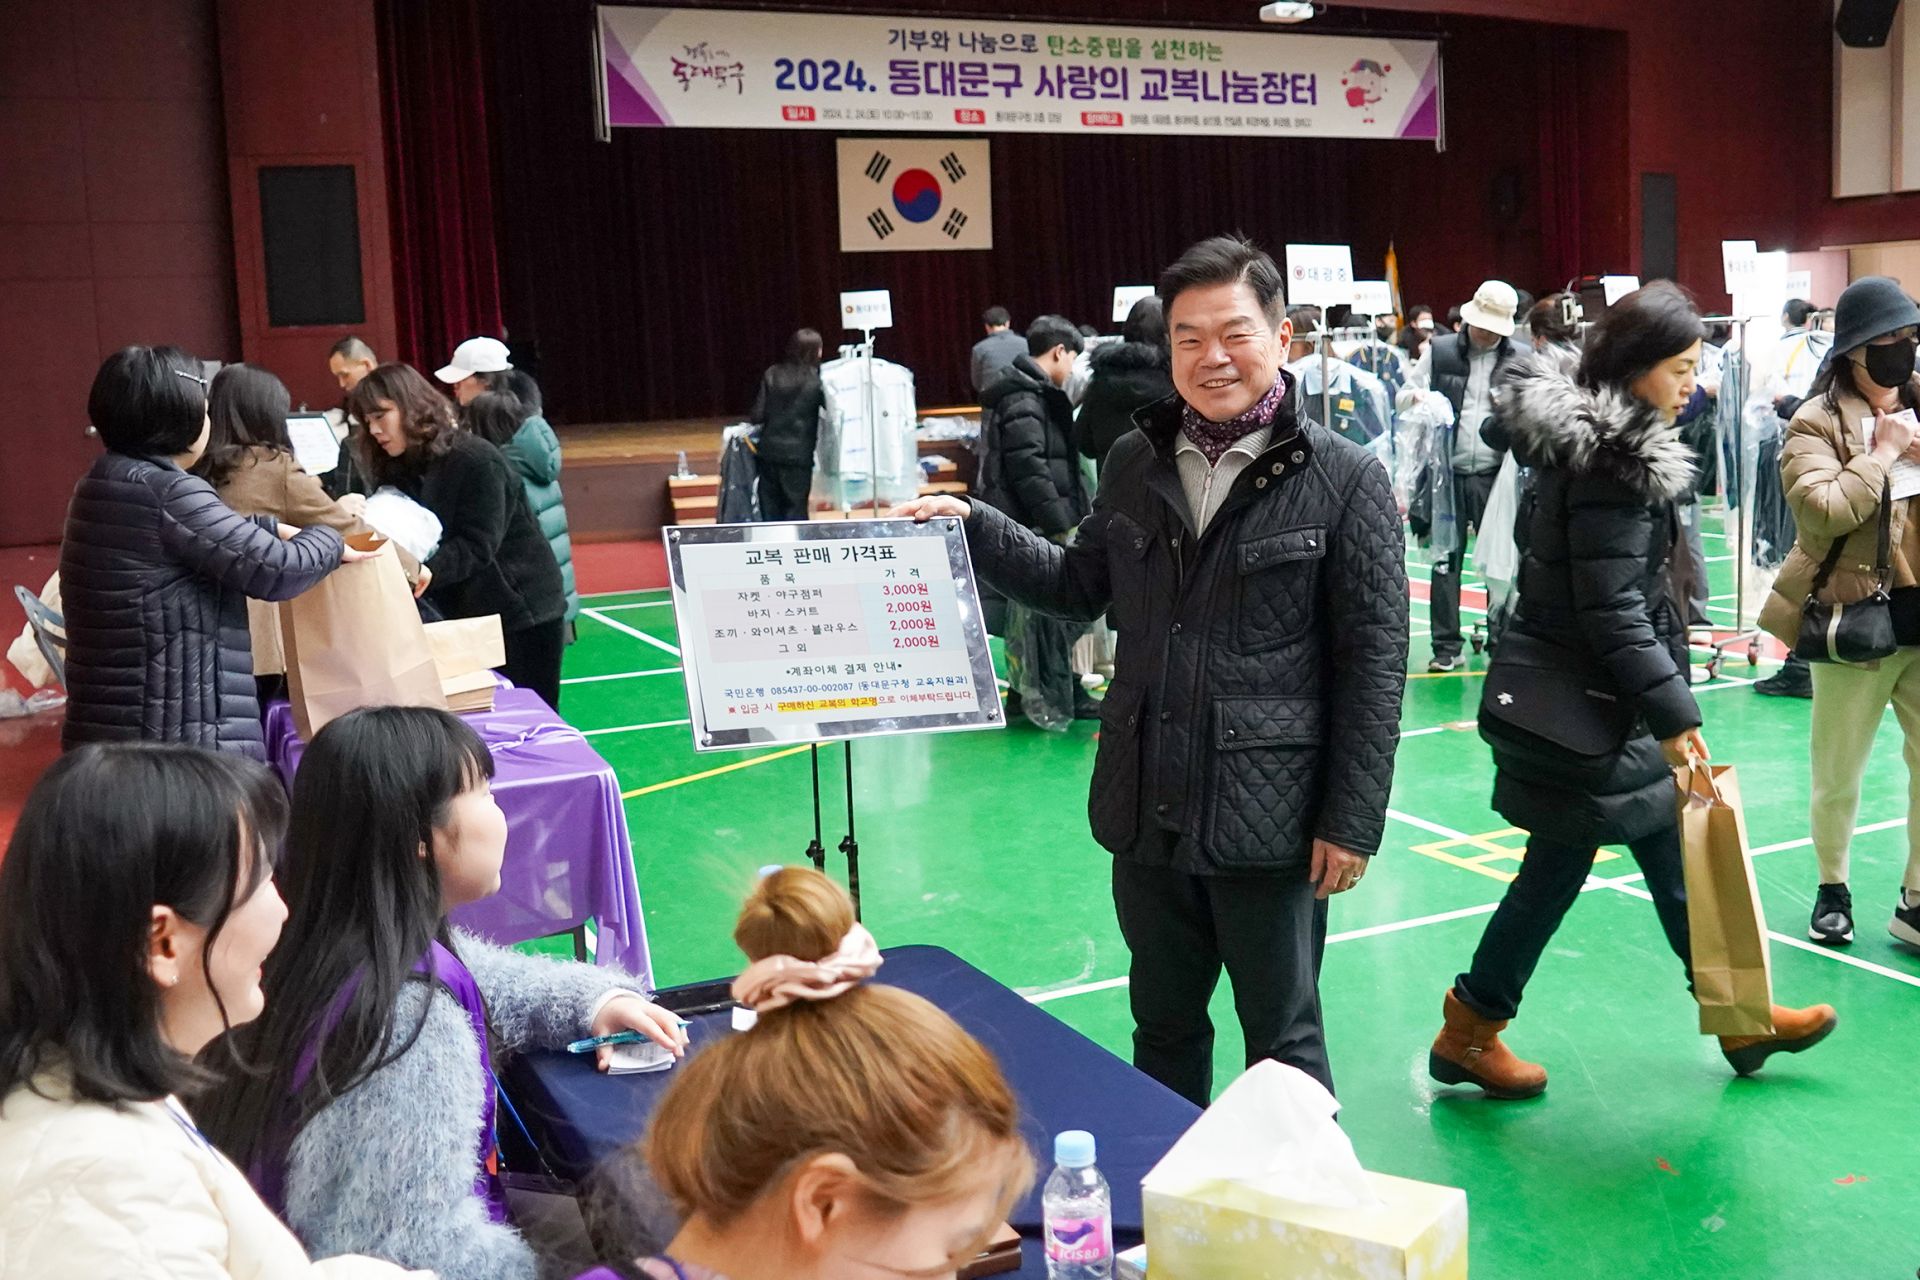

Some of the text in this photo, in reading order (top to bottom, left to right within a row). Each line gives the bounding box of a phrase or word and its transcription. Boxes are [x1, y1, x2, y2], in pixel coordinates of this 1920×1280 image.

[889, 29, 1223, 62] 기부와 나눔으로 탄소중립을 실천하는
[775, 58, 1318, 106] 2024. 동대문구 사랑의 교복나눔장터
[745, 545, 897, 566] 교복 판매 가격표
[737, 588, 823, 602] 자켓 야구점퍼
[883, 583, 929, 596] 3,000원
[747, 606, 819, 619] 바지 스커트
[886, 600, 933, 613] 2,000원
[715, 622, 858, 638] 조끼 와이셔츠 블라우스
[889, 618, 936, 631] 2,000원
[779, 642, 807, 653] 그 외
[893, 635, 940, 648] 2,000원
[845, 663, 867, 675] 결제
[724, 675, 968, 698] 국민은행 085437-00-002087 (동대문구청 교육지원과)
[740, 703, 759, 714] 입금
[764, 702, 773, 712] 시
[778, 700, 815, 711] 구매하신
